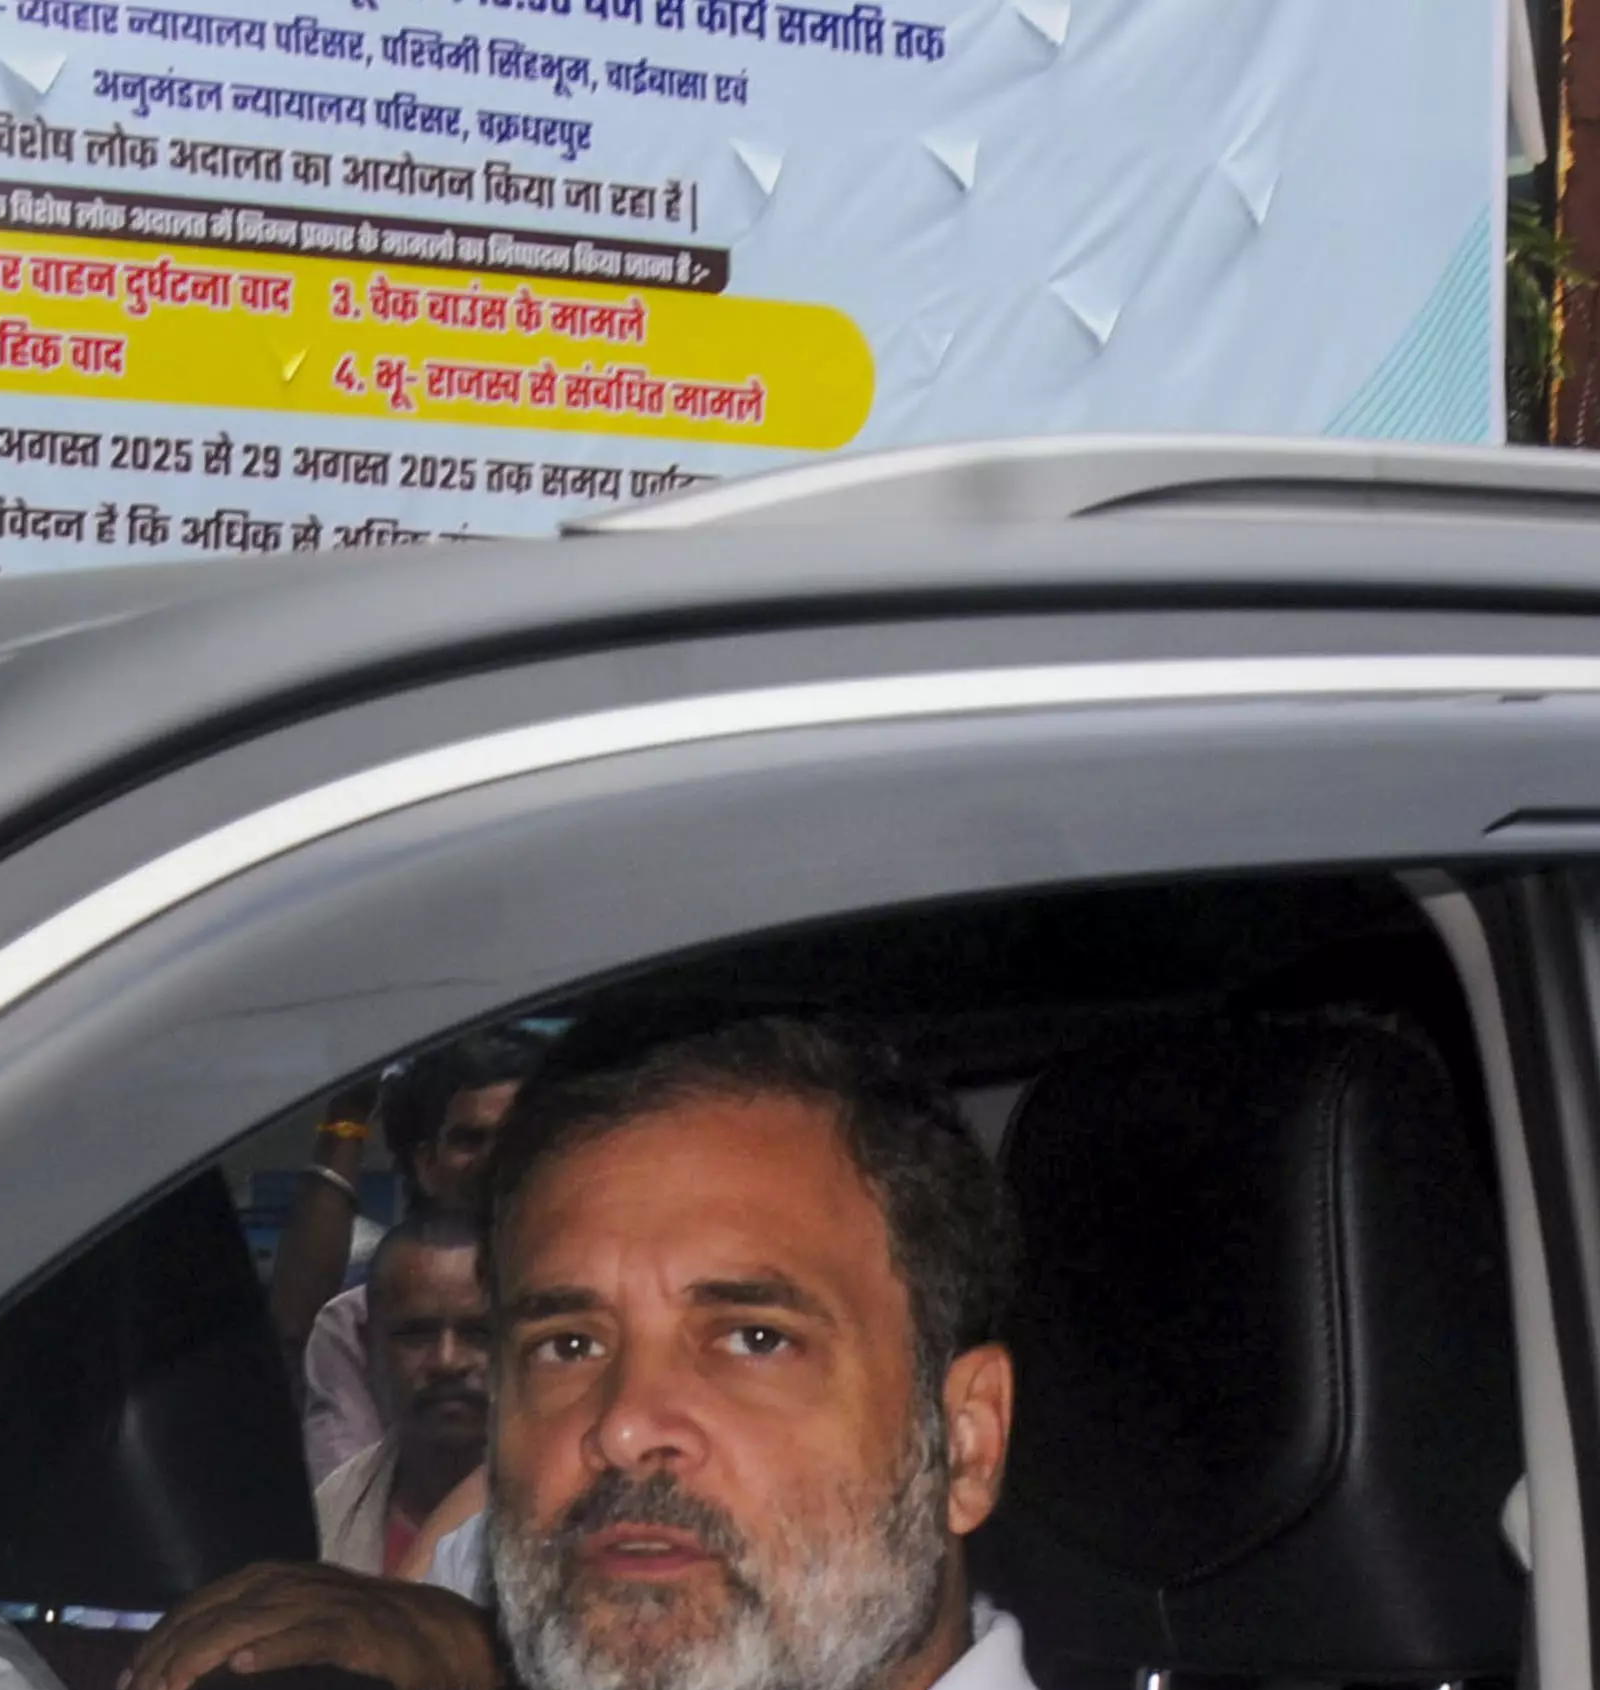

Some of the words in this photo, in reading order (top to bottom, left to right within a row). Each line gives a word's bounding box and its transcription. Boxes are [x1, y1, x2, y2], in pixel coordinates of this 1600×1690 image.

[17, 0, 119, 34] व्यवहार
[126, 6, 267, 51] न्यायालय
[274, 15, 373, 67] परिसर,
[381, 27, 481, 75] पश्चिमी
[487, 38, 598, 97] सिंहभूम,
[605, 57, 708, 101] चाईबासा
[714, 68, 749, 106] एवं
[892, 20, 946, 62] तक
[93, 67, 224, 119] अनुमंडल
[230, 83, 368, 127] न्यायालय
[374, 91, 469, 143] परिसर,
[477, 110, 592, 161] चक्रधरपुर
[83, 118, 159, 170] लोक
[169, 138, 285, 183] अदालत
[291, 150, 333, 190] का
[342, 151, 476, 203] आयोजन
[483, 153, 556, 208] किया
[564, 175, 601, 214] जा
[609, 181, 657, 220] रहा
[10, 189, 73, 226] विशेष
[75, 197, 127, 231] लोक
[130, 206, 208, 239] अदालत
[300, 221, 355, 252] प्रकार
[357, 221, 380, 253] के
[457, 236, 485, 264] का
[573, 241, 622, 276] किया
[30, 257, 118, 298] वाहन
[124, 258, 233, 317] दुर्घटना
[240, 274, 292, 313] वाद
[332, 282, 363, 322] 3.
[369, 275, 420, 323] चेक
[514, 289, 543, 333] के
[550, 298, 646, 342] मामले
[71, 335, 125, 374] वाद
[334, 357, 367, 394] 4.
[427, 363, 523, 403] राजस्व
[529, 364, 559, 406] से
[564, 366, 666, 414] संबंधित
[672, 380, 765, 421] मामले
[110, 434, 193, 474] 2025
[202, 431, 235, 477] से
[242, 443, 282, 480] 29
[292, 445, 393, 487] अगस्त
[399, 452, 478, 492] 2025
[485, 460, 535, 495] तक
[541, 463, 621, 500] समय
[94, 503, 120, 546] है
[126, 506, 173, 548] कि
[181, 510, 285, 553] अधिक
[291, 515, 325, 553] से
